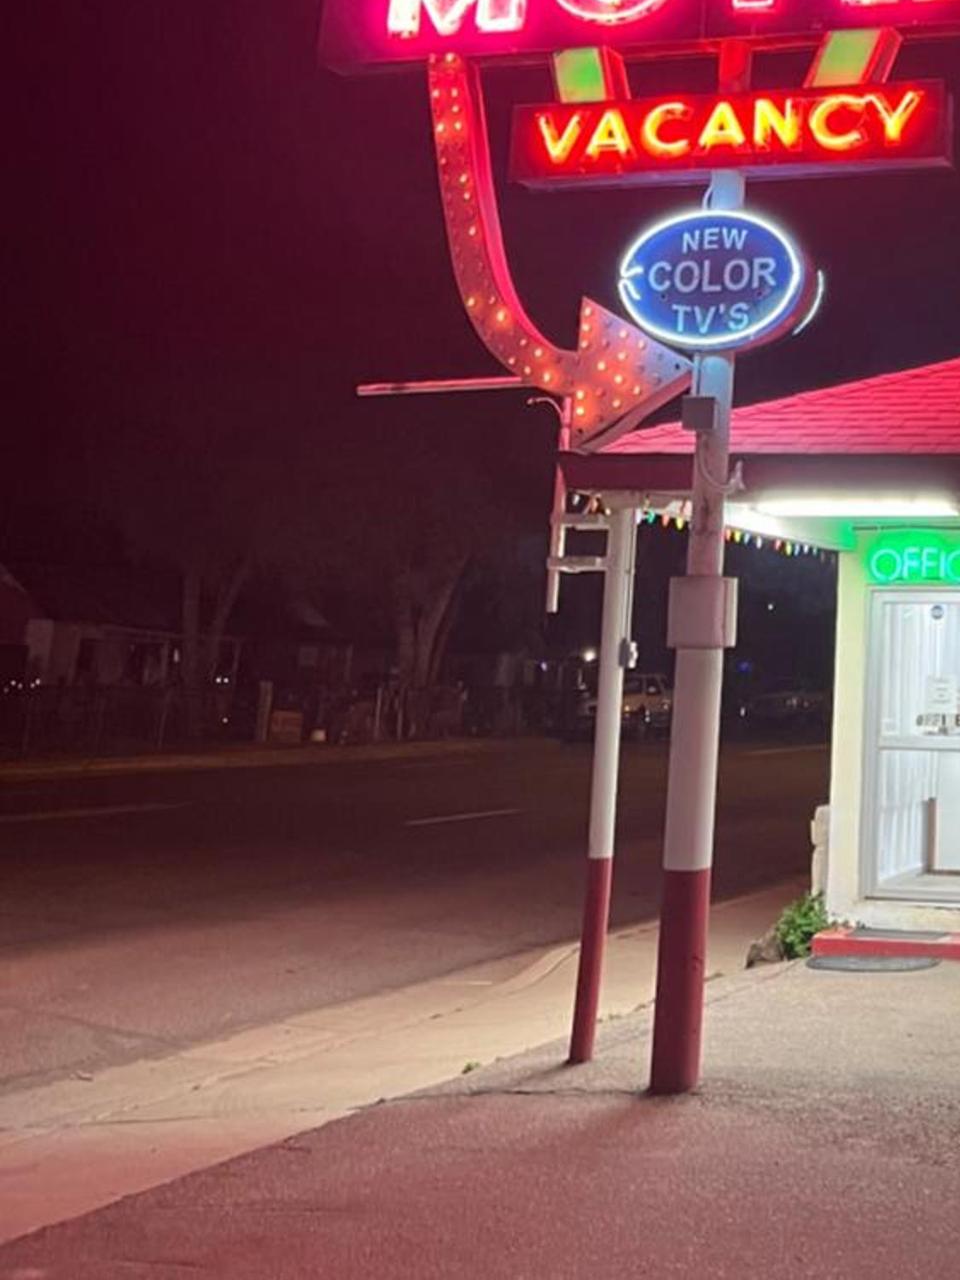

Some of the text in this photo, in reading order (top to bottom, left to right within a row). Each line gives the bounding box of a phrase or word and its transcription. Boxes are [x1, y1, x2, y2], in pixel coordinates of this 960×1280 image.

[537, 90, 919, 166] VACANCY
[682, 227, 748, 253] NEW
[648, 257, 777, 293] COLOR
[672, 302, 750, 333] TV'S
